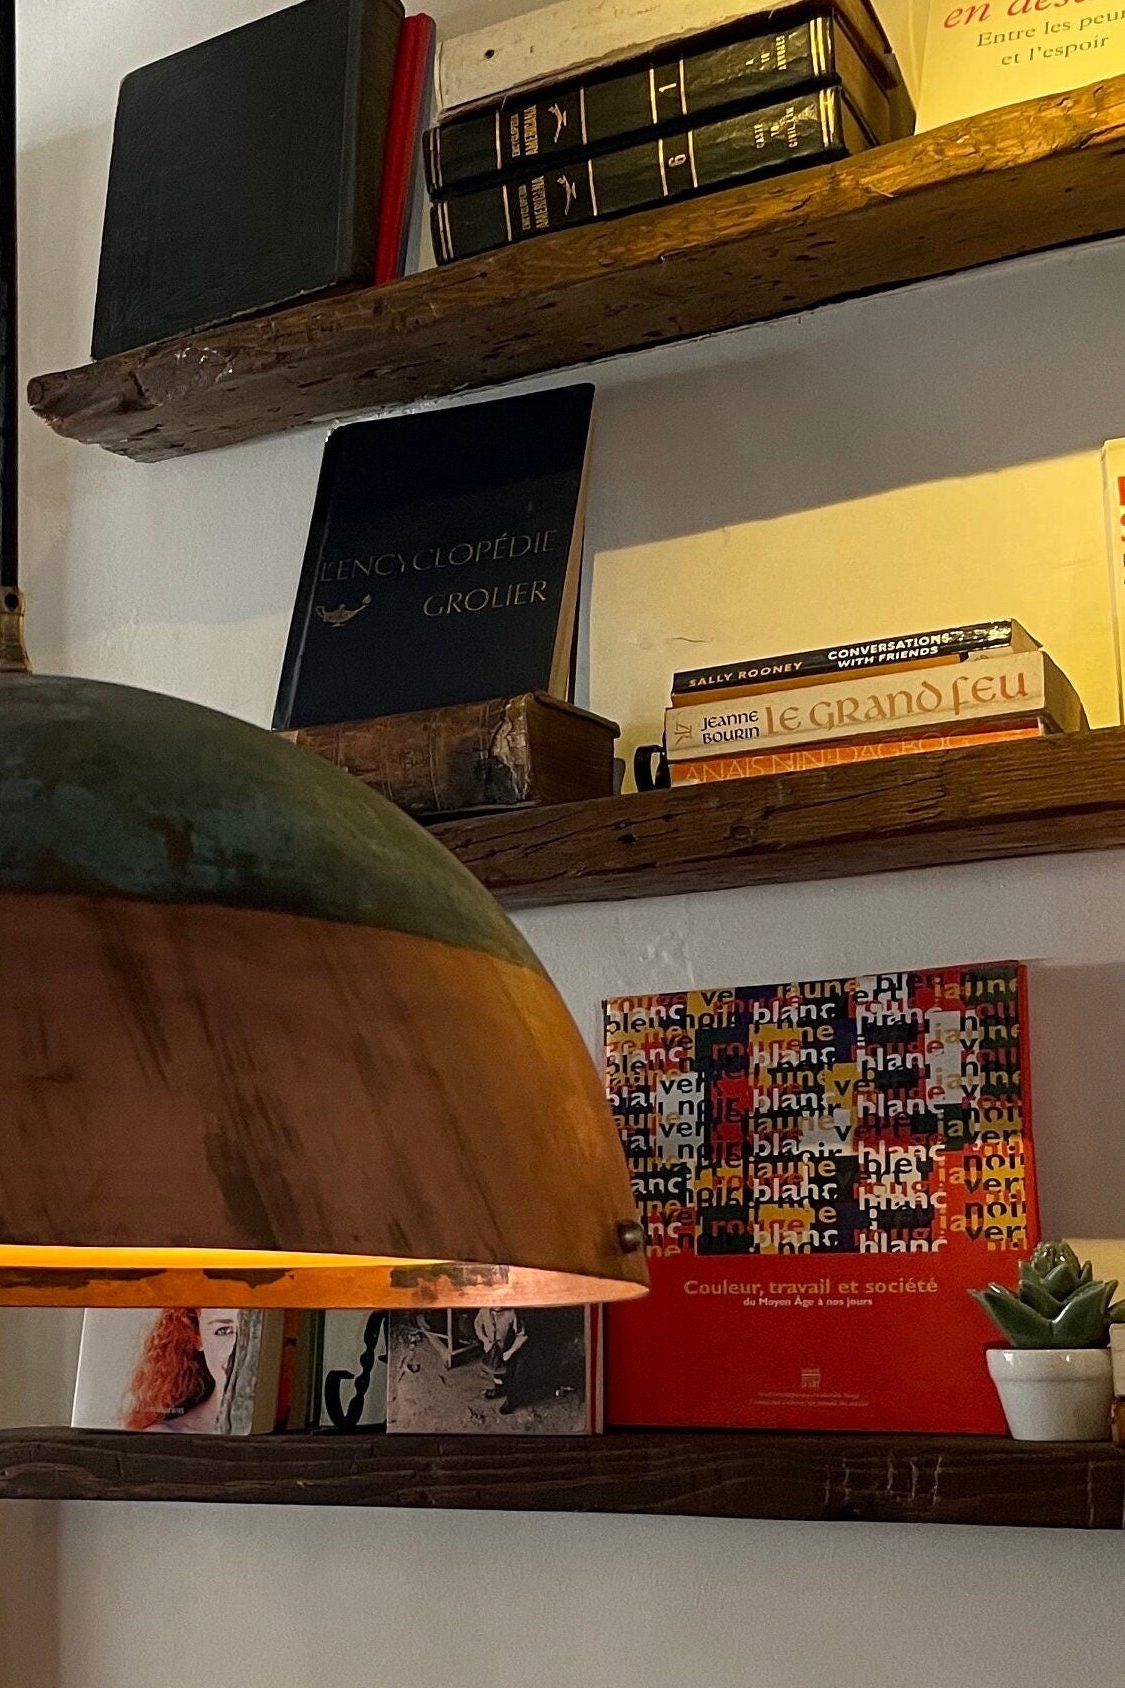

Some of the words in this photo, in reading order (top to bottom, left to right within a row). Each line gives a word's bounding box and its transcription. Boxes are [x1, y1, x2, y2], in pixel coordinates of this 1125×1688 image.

[943, 0, 991, 29] en
[977, 28, 1036, 47] Entre
[1044, 21, 1071, 35] les
[1001, 52, 1020, 65] et
[1030, 34, 1110, 61] l'espoir
[658, 82, 677, 93] 1
[523, 104, 539, 156] AMERICANA
[667, 153, 686, 168] 6
[531, 175, 549, 229] AMERICANA
[423, 580, 547, 617] GROLIER
[828, 633, 950, 661] CONVERSATIONS
[838, 656, 874, 668] WITH
[878, 646, 939, 662] FRIENDS
[689, 672, 733, 687] SALLY
[738, 662, 803, 680] ROONEY
[702, 726, 760, 744] BOURIN
[683, 1279, 765, 1297] Couleur,
[769, 1278, 831, 1294] travail
[838, 1280, 859, 1294] et
[865, 1277, 939, 1294] société
[743, 1297, 756, 1306] du
[759, 1297, 791, 1308] Moyen
[846, 1297, 873, 1308] jours
